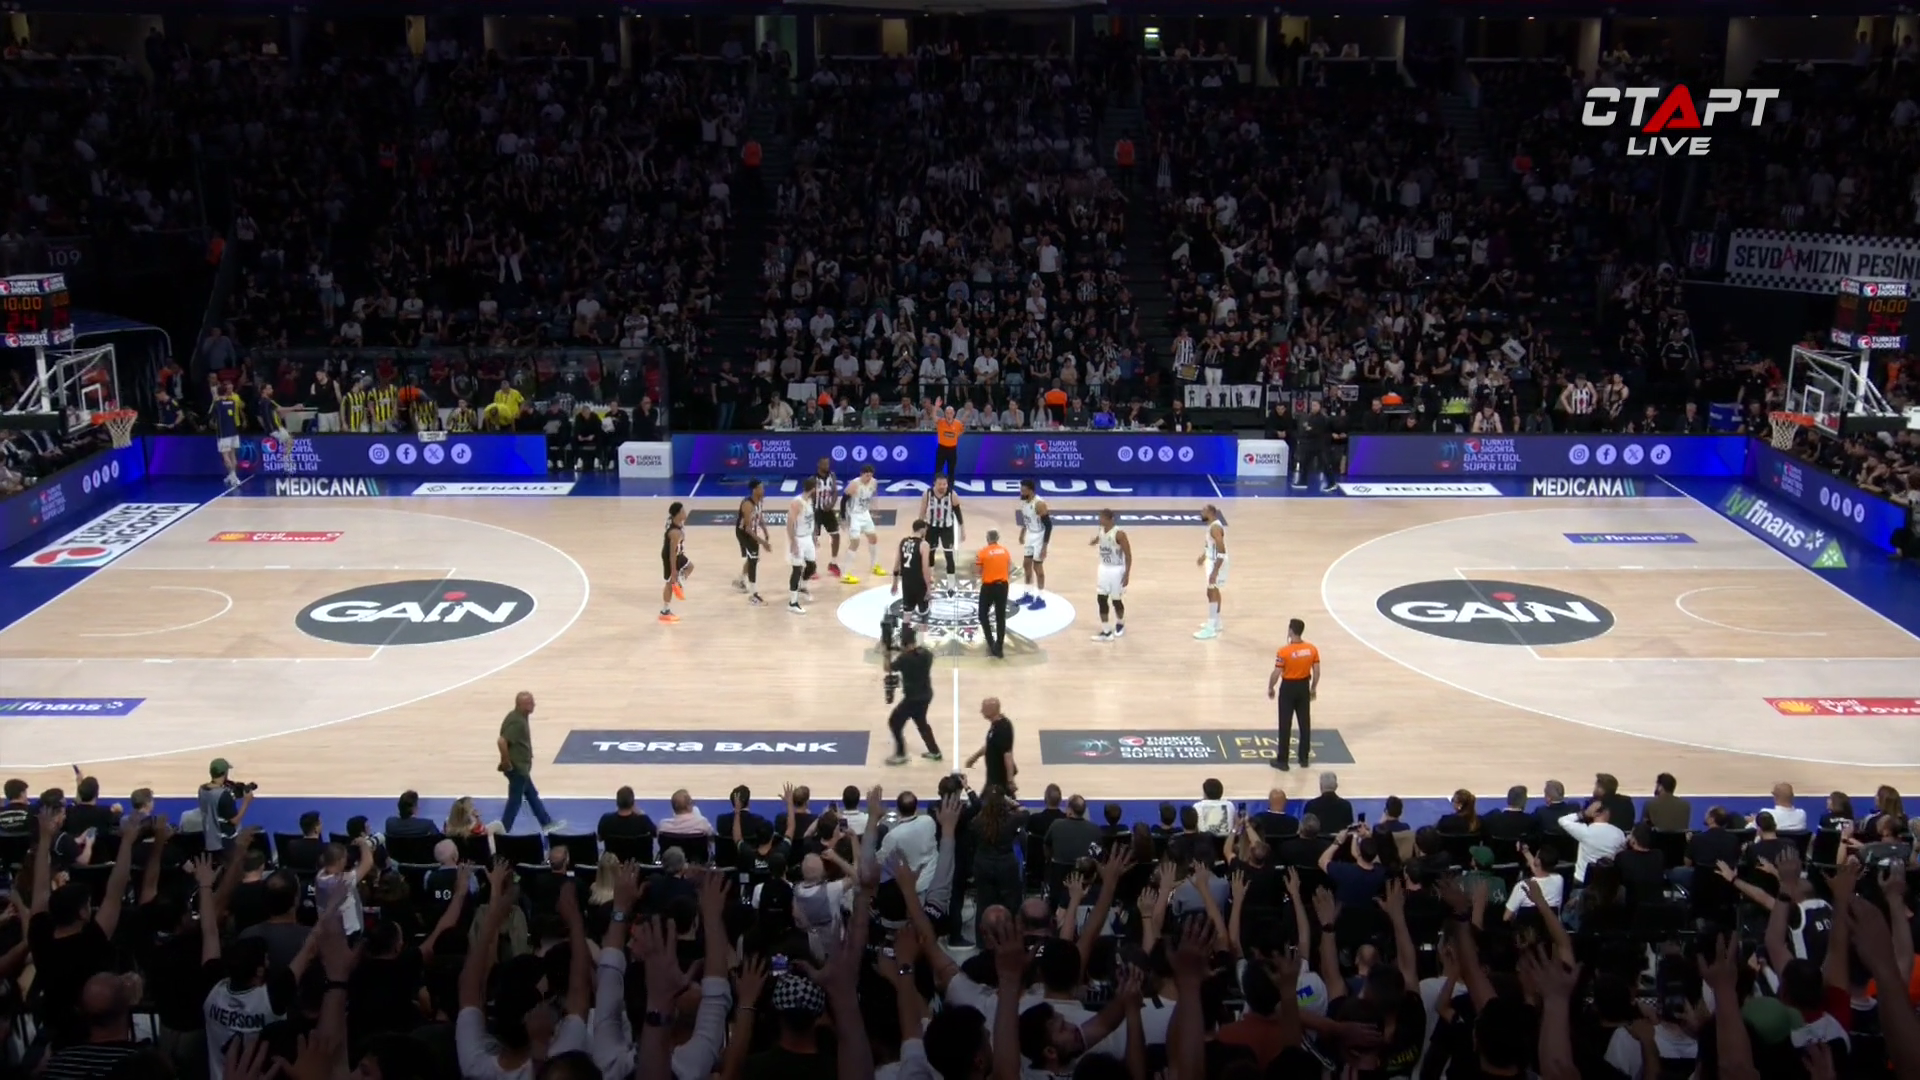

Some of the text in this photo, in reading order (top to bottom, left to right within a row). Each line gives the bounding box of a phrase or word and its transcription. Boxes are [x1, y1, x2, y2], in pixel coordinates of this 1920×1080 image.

[47, 249, 81, 267] 109
[1734, 244, 1852, 275] SEVDAMIZIN
[1463, 454, 1522, 462] BASKETBOL
[275, 477, 367, 496] MEDICANA
[1533, 477, 1624, 496] MEDICANA
[1725, 487, 1805, 548] iyifinans
[903, 553, 912, 568] 7
[714, 741, 838, 752] BANK
[209, 1003, 265, 1029] IVERSON
